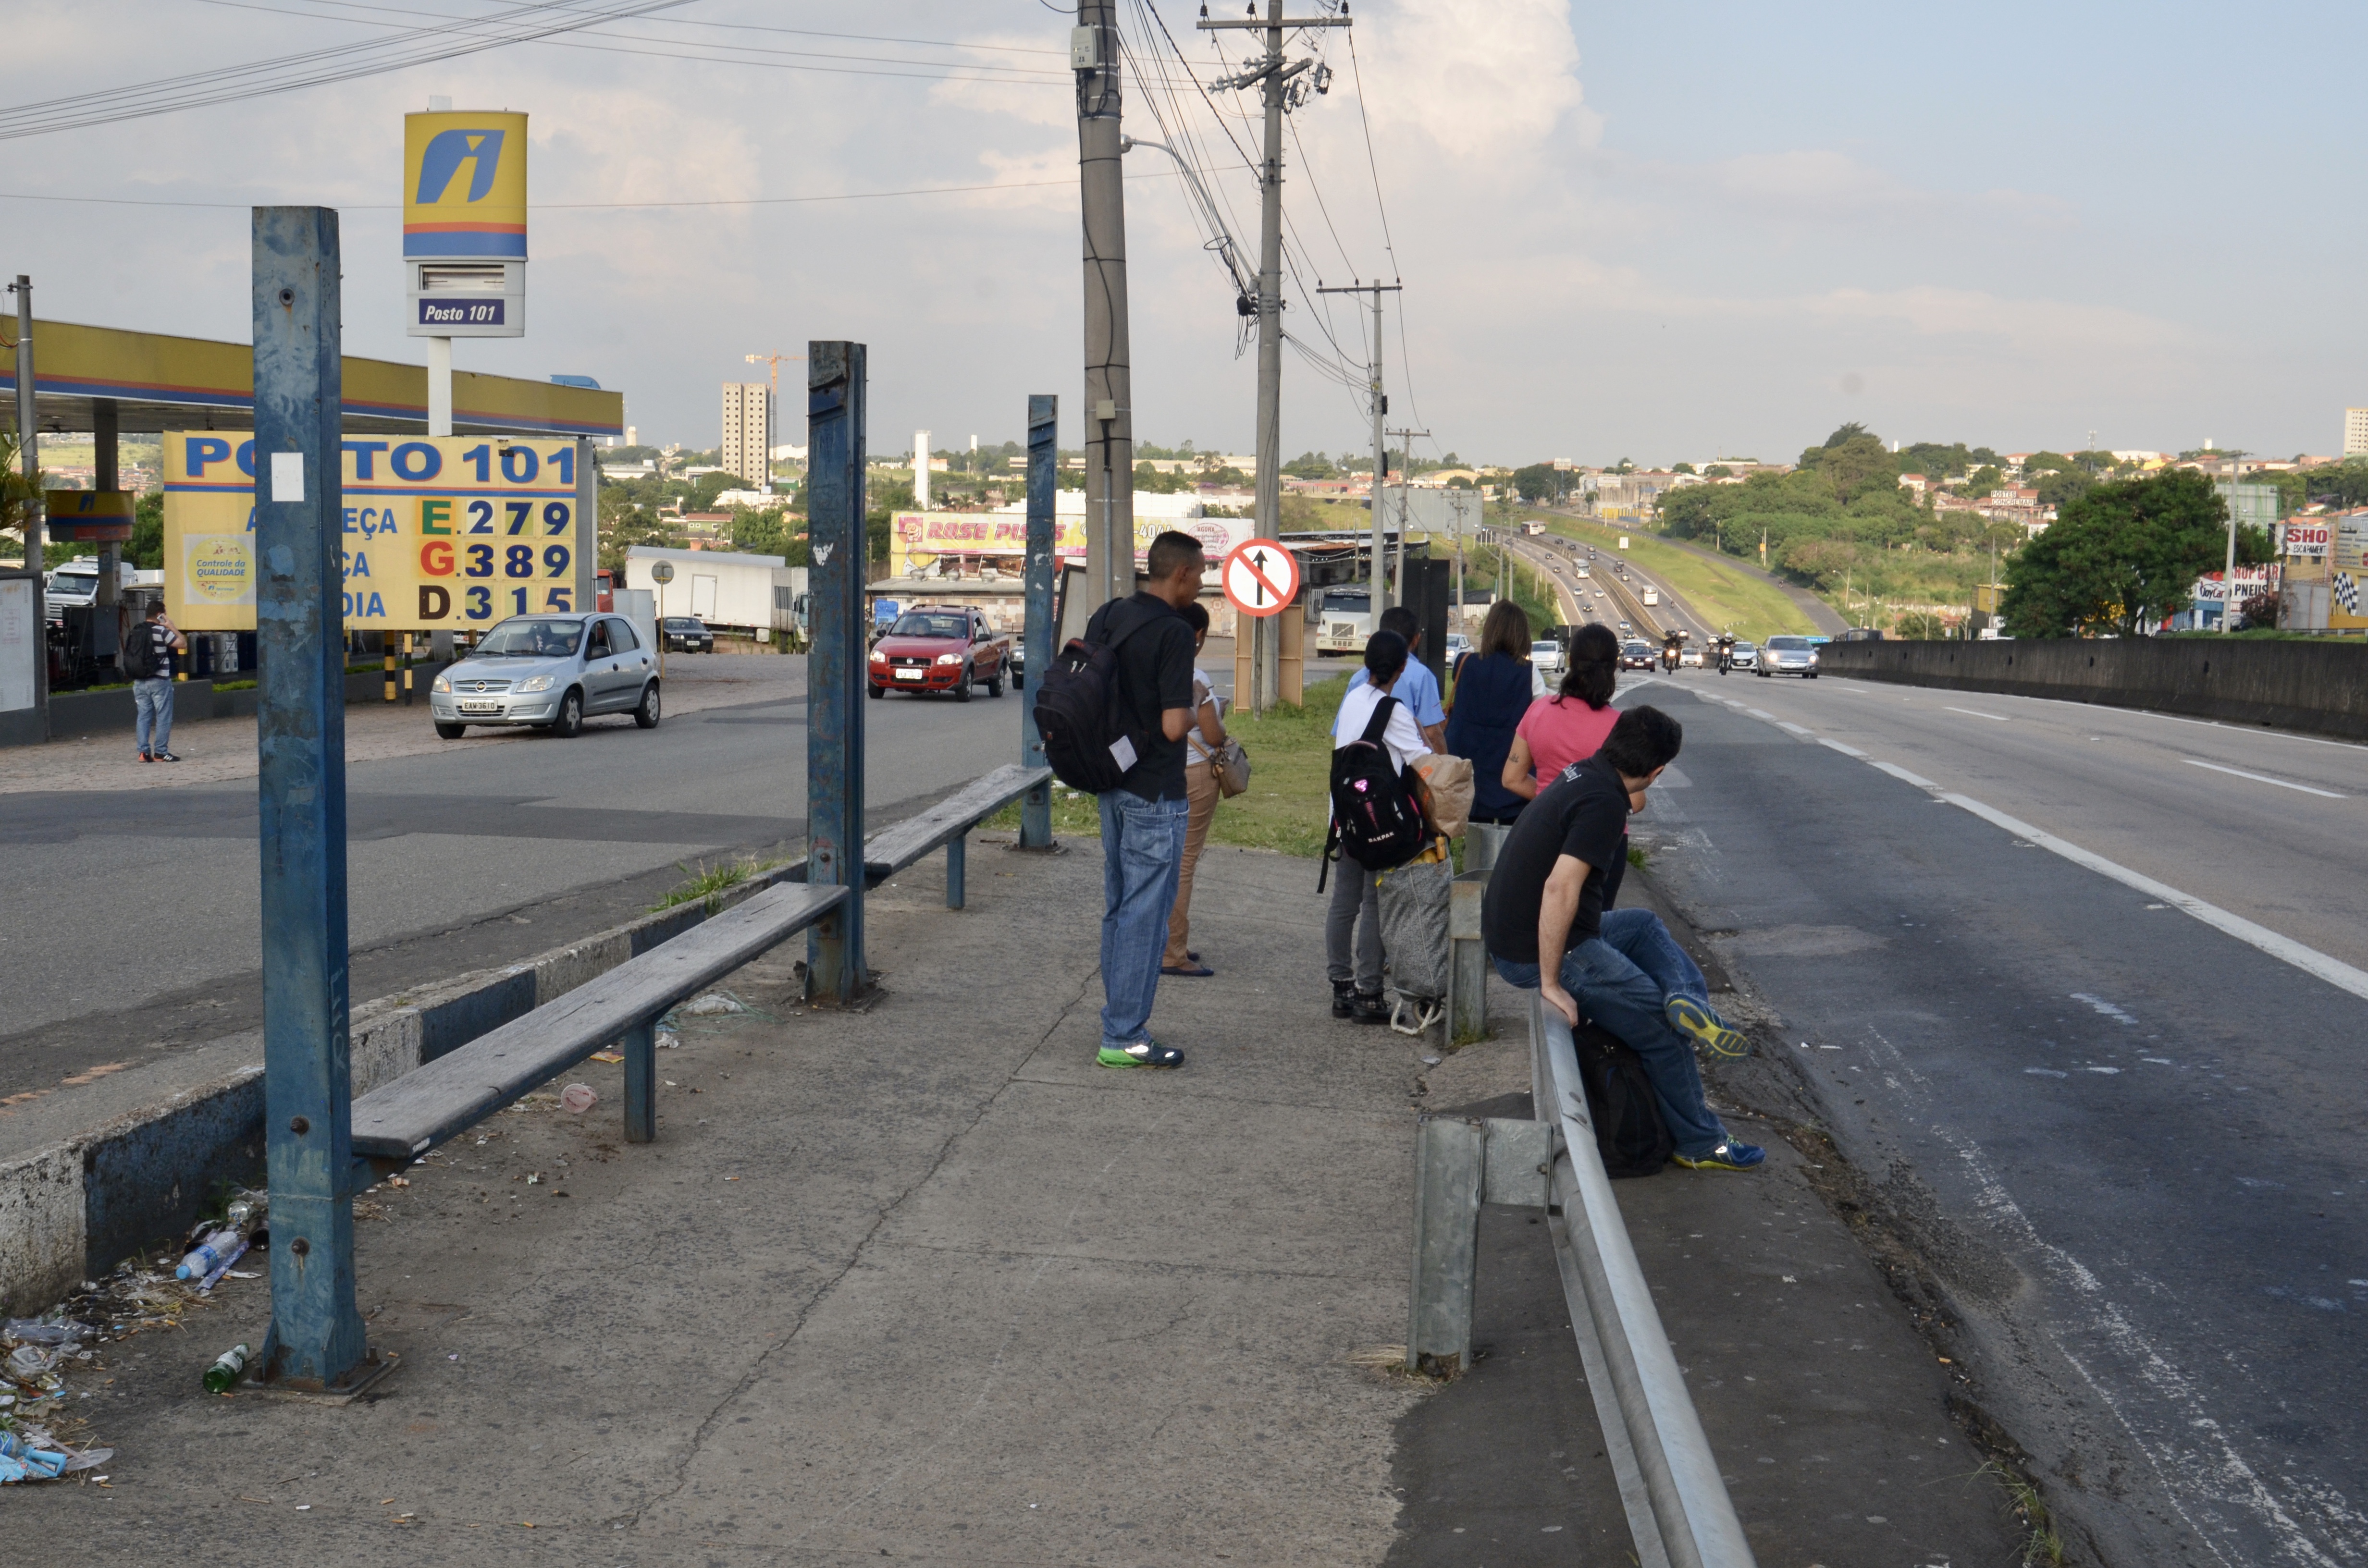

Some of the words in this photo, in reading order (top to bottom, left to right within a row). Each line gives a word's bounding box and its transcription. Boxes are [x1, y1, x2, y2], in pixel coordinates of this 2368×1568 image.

[425, 305, 464, 320] Posto
[469, 306, 495, 321] 101
[186, 437, 443, 482] PTO
[463, 444, 575, 485] 101
[468, 500, 570, 536] 279
[926, 522, 989, 540] ROSE
[994, 523, 1067, 542] PISS
[465, 544, 570, 578] 389
[197, 568, 246, 577] QUALIDADE
[2232, 566, 2257, 580] HOP
[1368, 832, 1394, 843] BAKPAK
